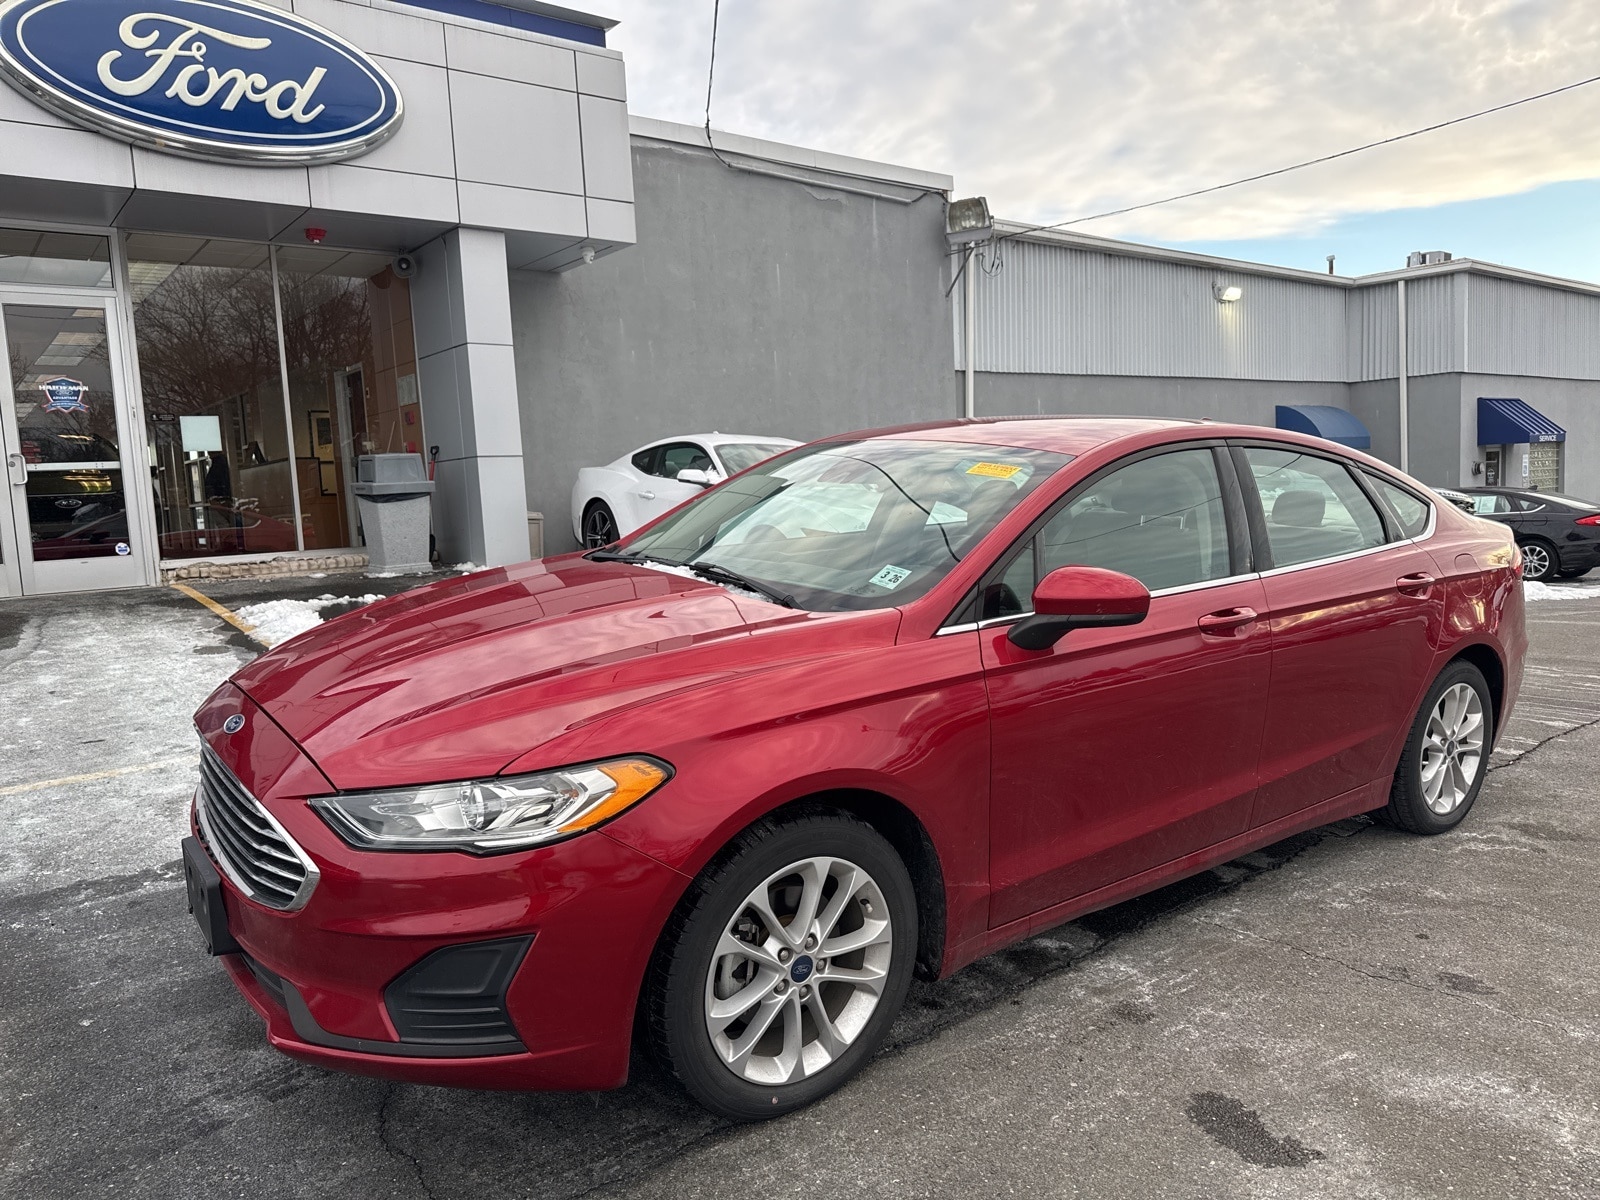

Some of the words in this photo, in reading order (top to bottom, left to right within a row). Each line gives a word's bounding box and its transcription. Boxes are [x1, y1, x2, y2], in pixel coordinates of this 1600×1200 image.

[97, 12, 327, 124] Ford
[1539, 434, 1557, 442] SERVICE
[880, 571, 890, 579] 3
